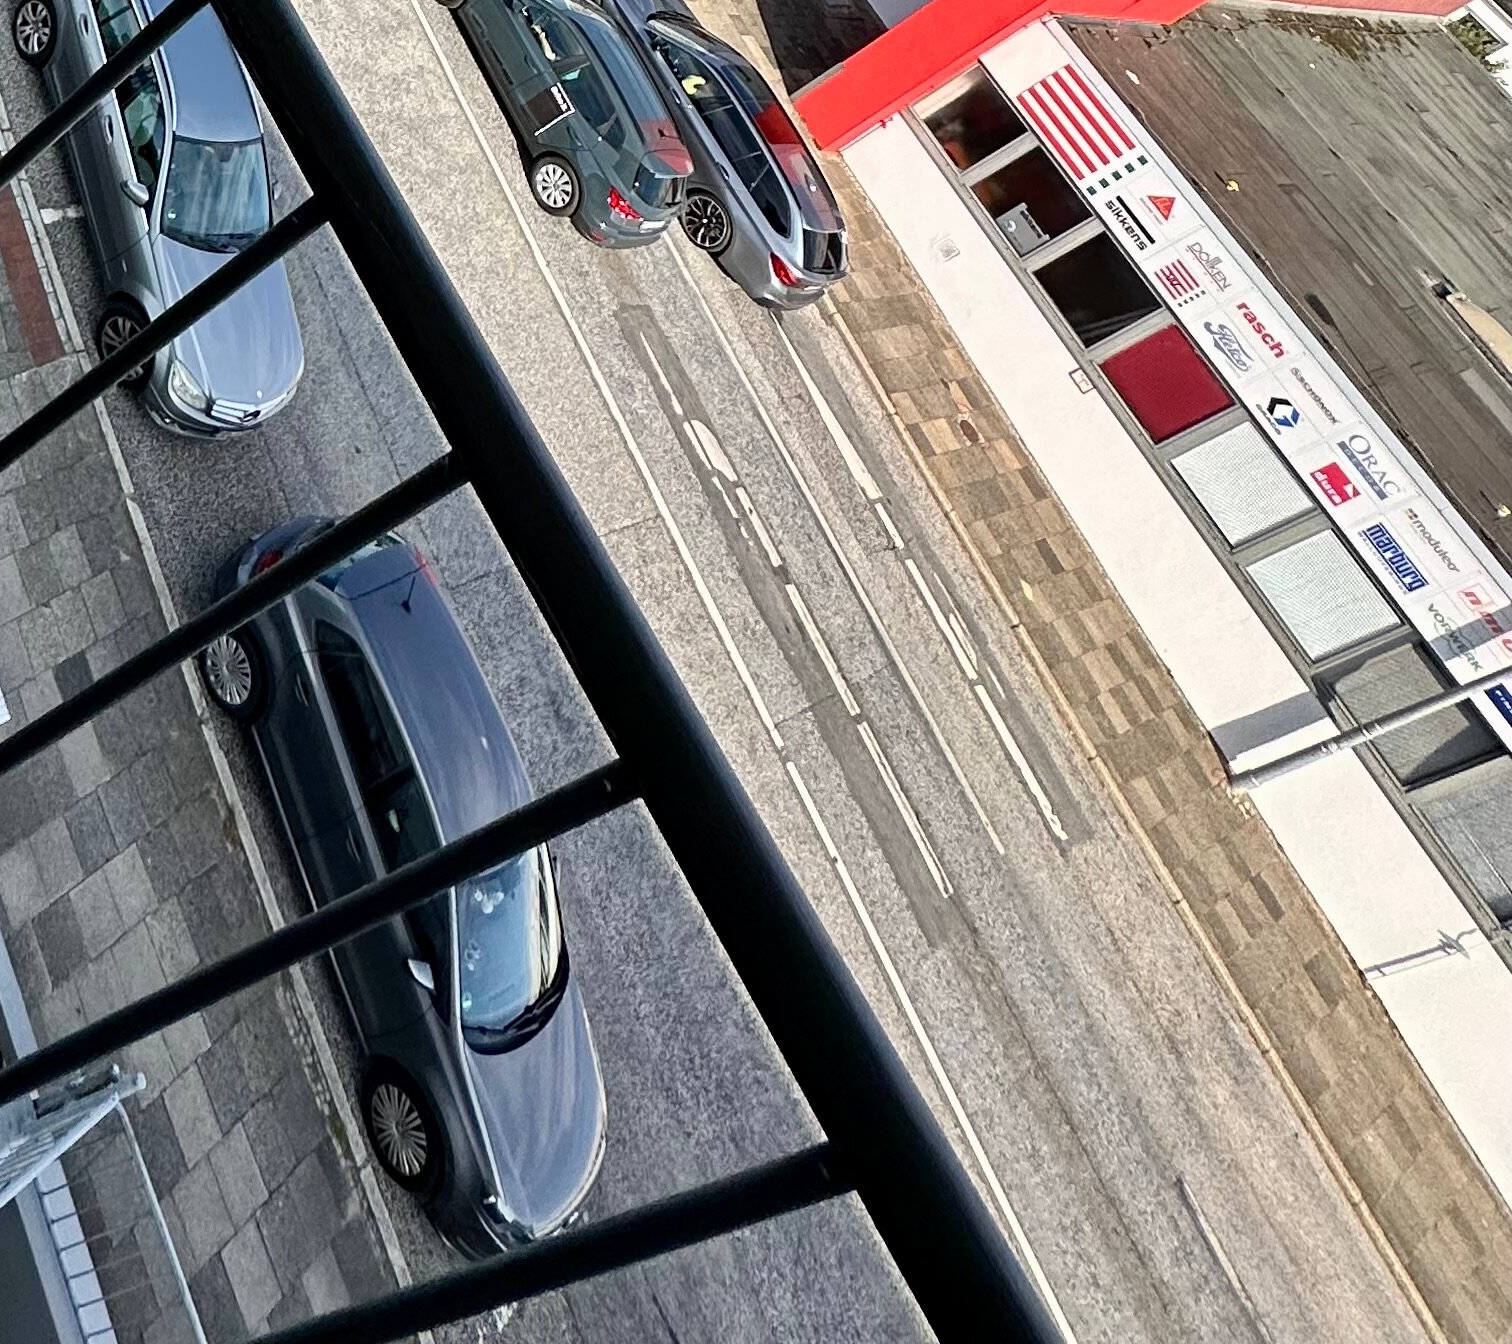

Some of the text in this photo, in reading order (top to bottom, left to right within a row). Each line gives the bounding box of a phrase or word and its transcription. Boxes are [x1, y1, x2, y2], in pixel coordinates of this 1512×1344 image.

[1104, 198, 1148, 251] sikkens
[1236, 302, 1286, 359] rasch
[1314, 471, 1342, 504] dura
[1365, 523, 1425, 592] marburg
[1412, 518, 1457, 571] moduleo
[1427, 602, 1482, 671] VORWERK
